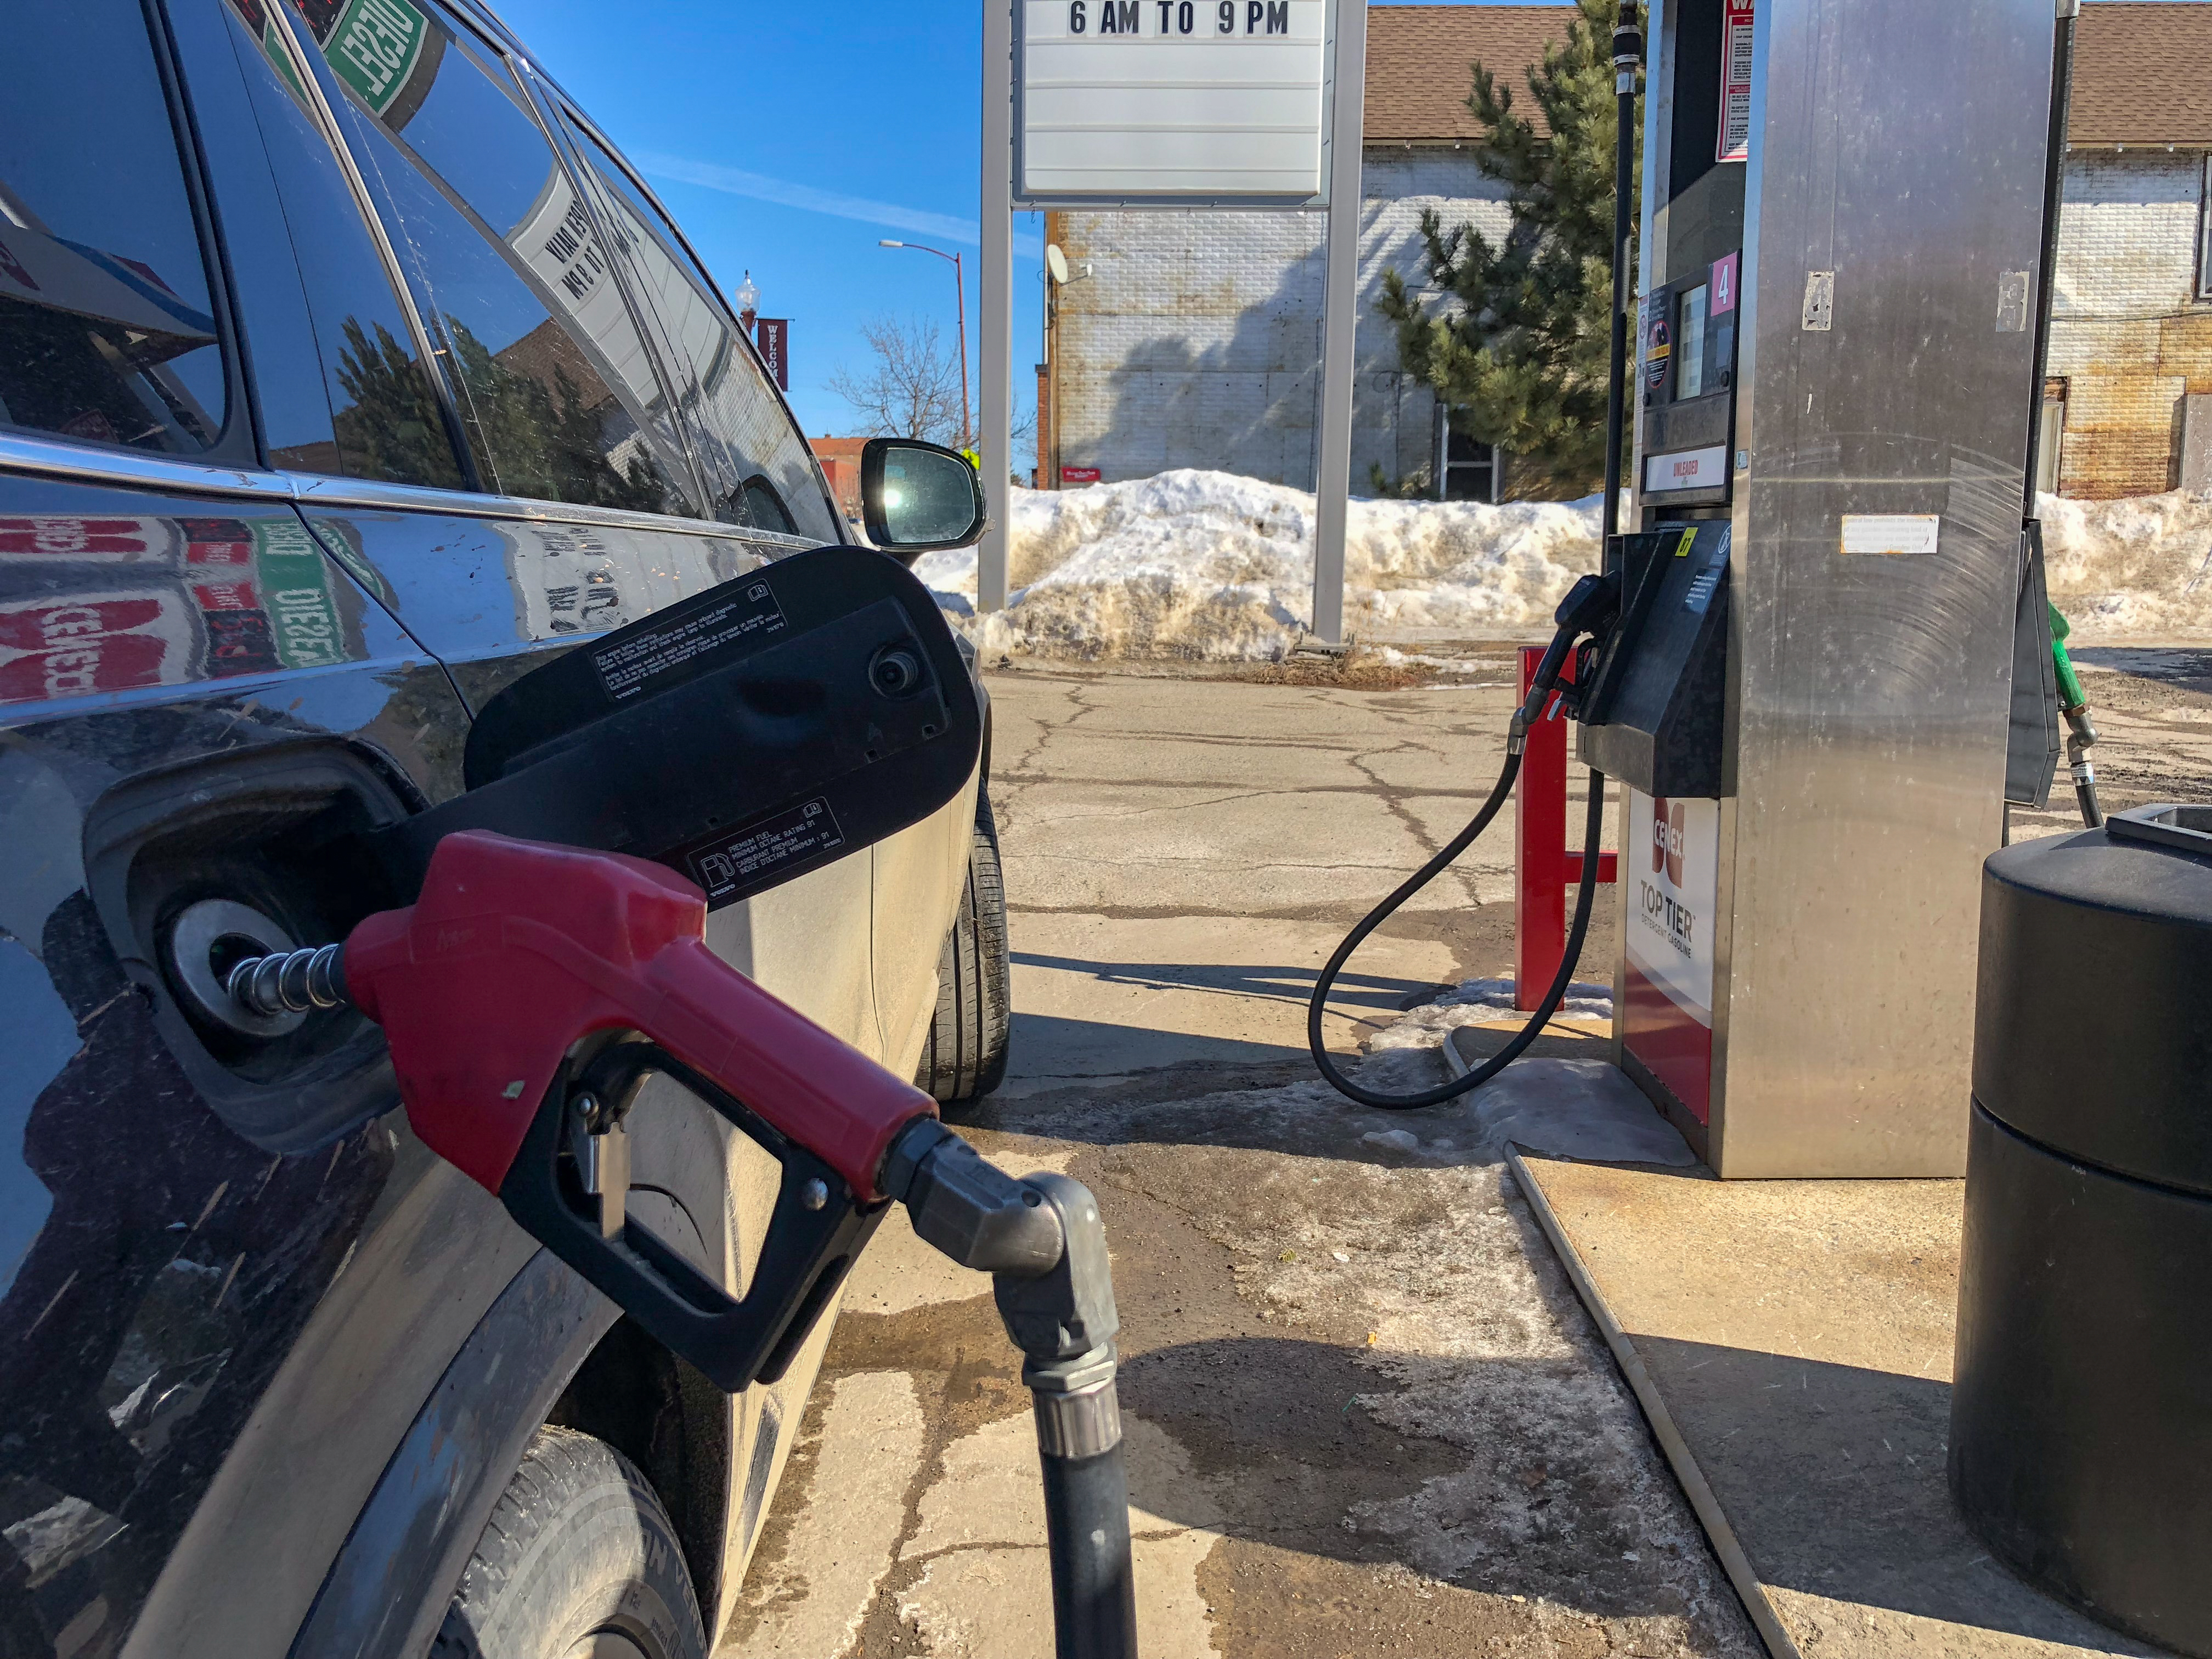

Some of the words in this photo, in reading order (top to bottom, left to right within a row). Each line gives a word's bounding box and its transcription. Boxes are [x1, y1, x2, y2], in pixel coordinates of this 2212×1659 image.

[1070, 1, 1086, 33] 6
[1100, 1, 1139, 33] AM
[1157, 1, 1193, 34] TO
[1218, 1, 1234, 33] 9
[1247, 1, 1288, 33] PM
[1718, 264, 1729, 304] 4
[768, 325, 778, 377] WELCOM
[1673, 460, 1698, 476] UNLEADED
[1680, 537, 1691, 553] 87
[616, 686, 641, 699] VOLVO
[728, 837, 755, 853] PREMIUM
[755, 830, 772, 841] FUEL
[731, 844, 758, 859] MINIMUM
[759, 834, 782, 848] OCTANE
[783, 823, 806, 837] RATING
[806, 819, 815, 827] 91
[736, 849, 770, 867] CARBURANT
[771, 837, 798, 852] PREMIUM
[739, 862, 759, 874] INDICE
[789, 837, 815, 853] MINIMUM
[820, 831, 830, 839] 91
[1654, 820, 1683, 859] CENEX
[710, 884, 736, 897] VOLVO
[1641, 879, 1663, 917] TOP
[1641, 913, 1667, 940] DETERGENT
[1667, 933, 1691, 958] GASOLINE
